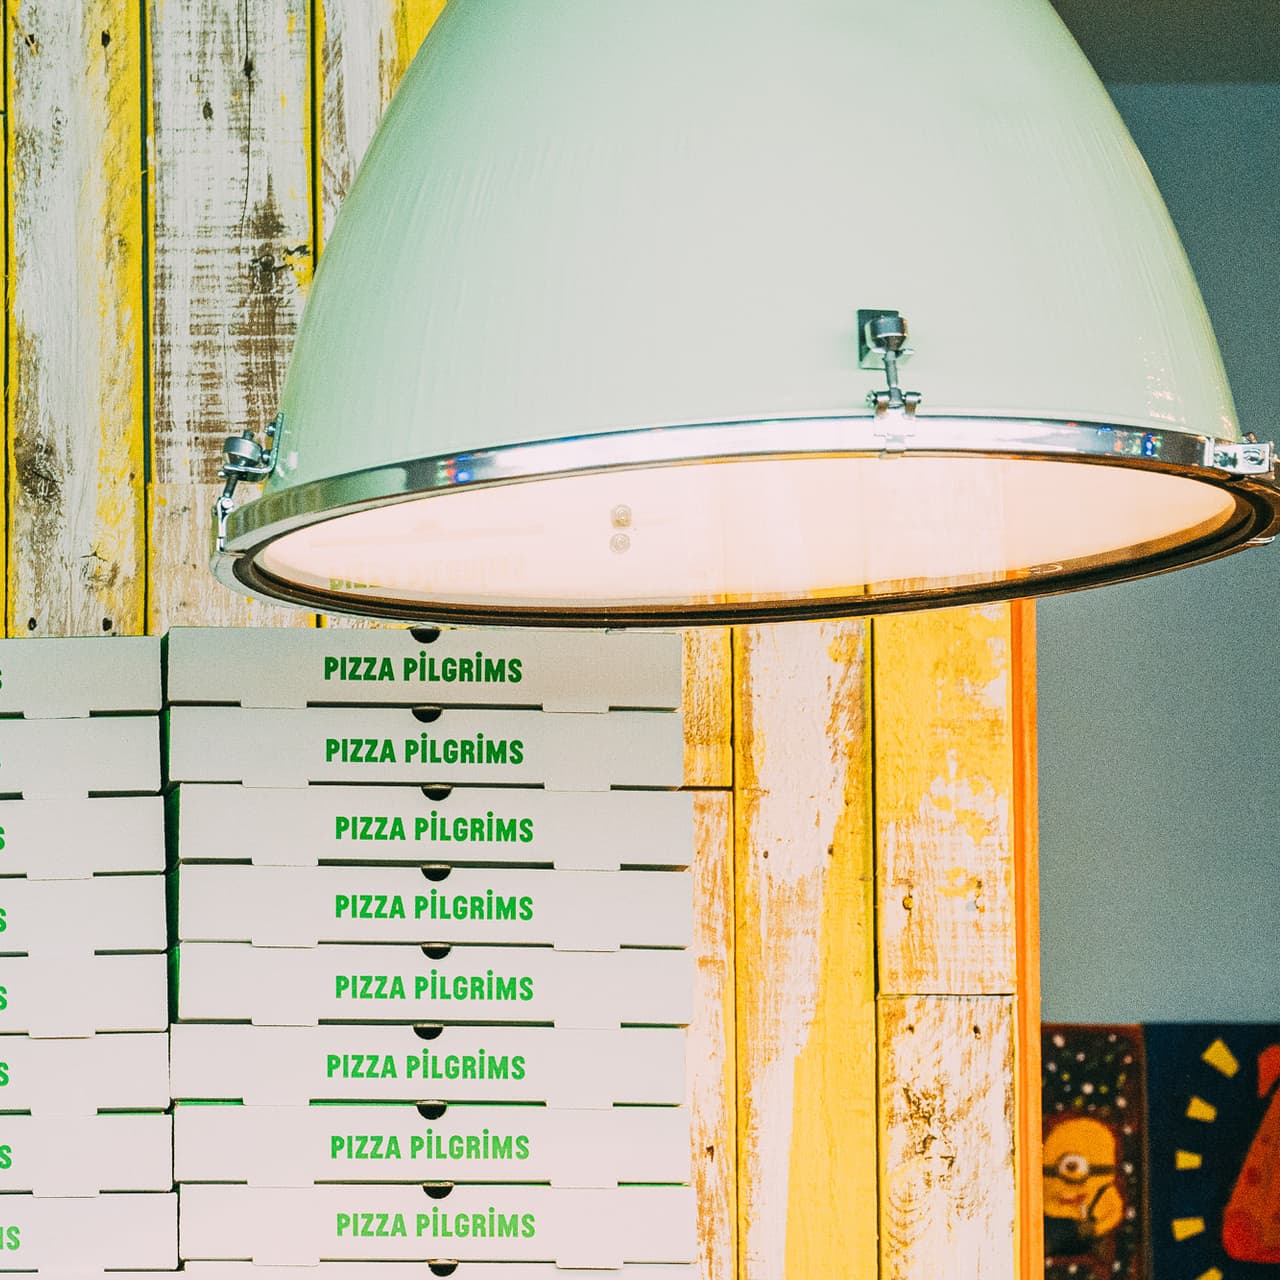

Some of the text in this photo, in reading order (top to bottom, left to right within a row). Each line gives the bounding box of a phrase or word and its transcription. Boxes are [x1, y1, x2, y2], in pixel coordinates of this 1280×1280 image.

[324, 656, 394, 681] PIZZA
[325, 738, 396, 763] PIZZA
[336, 816, 406, 841] PIZZA
[336, 975, 406, 1000] PIZZA
[327, 1054, 397, 1079] PIZZA
[331, 1136, 401, 1159] PIZZA
[337, 1213, 406, 1237] PIZZA
